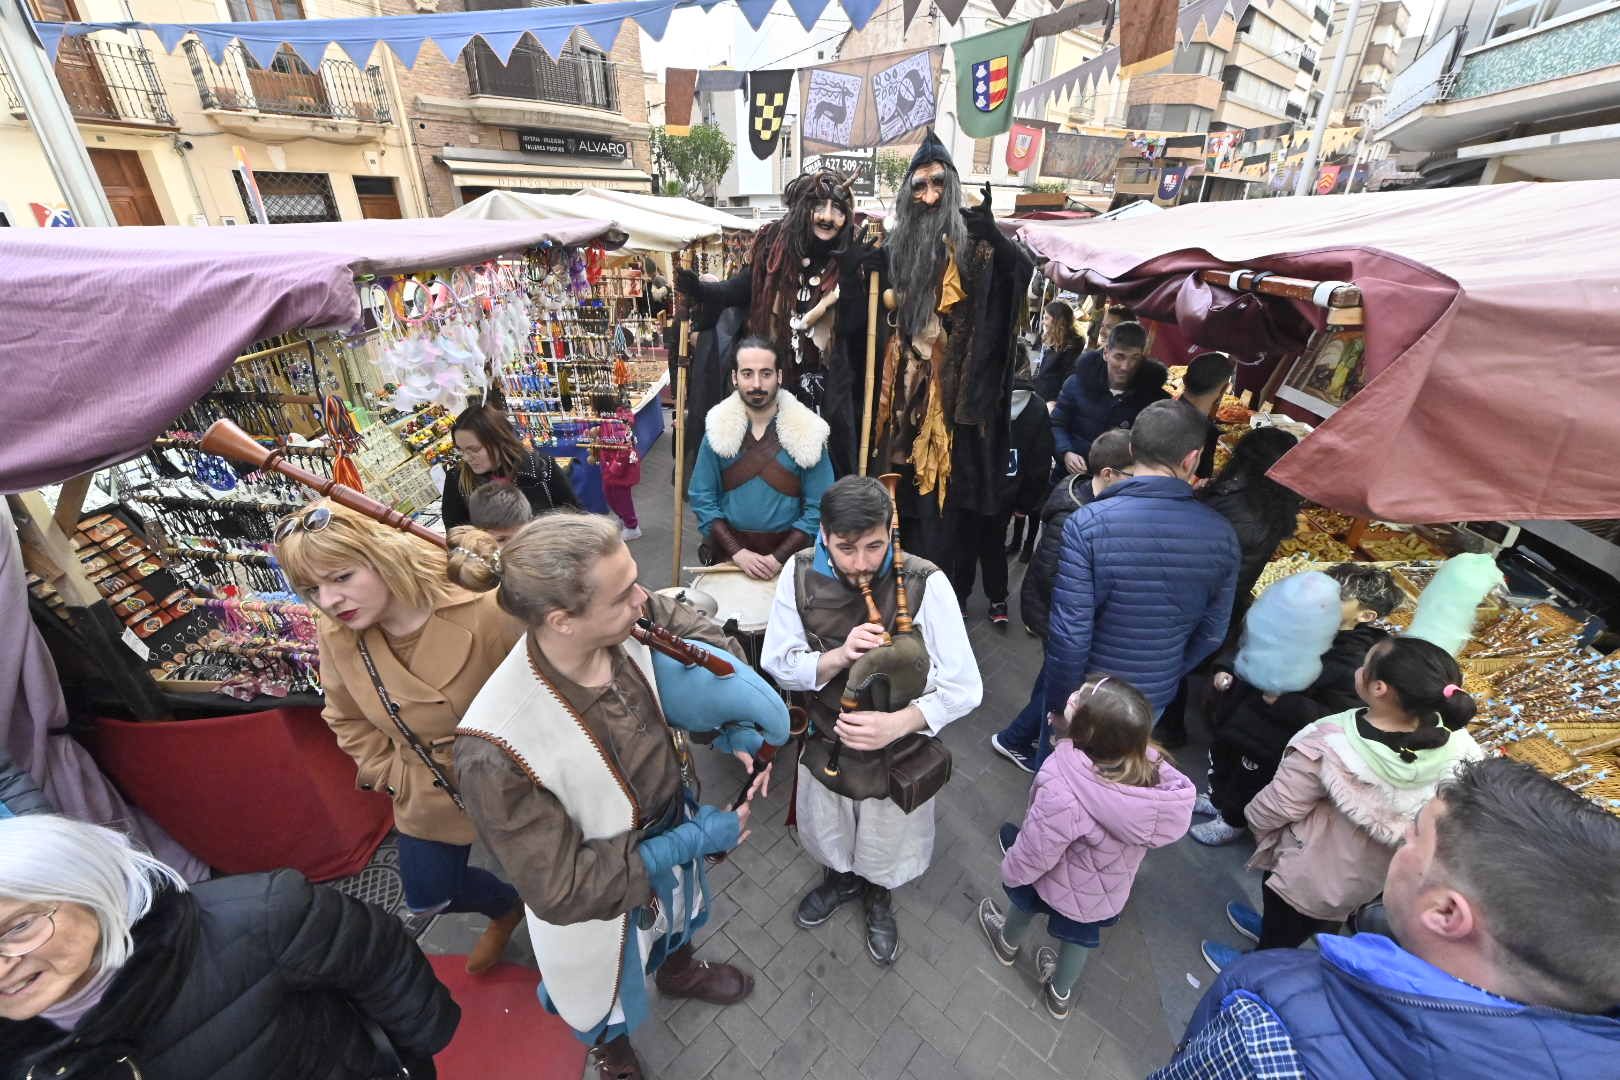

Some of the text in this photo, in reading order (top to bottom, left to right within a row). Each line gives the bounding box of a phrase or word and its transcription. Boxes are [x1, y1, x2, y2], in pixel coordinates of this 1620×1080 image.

[579, 140, 625, 154] ALVARO
[825, 158, 841, 170] 627
[842, 159, 857, 171] 509
